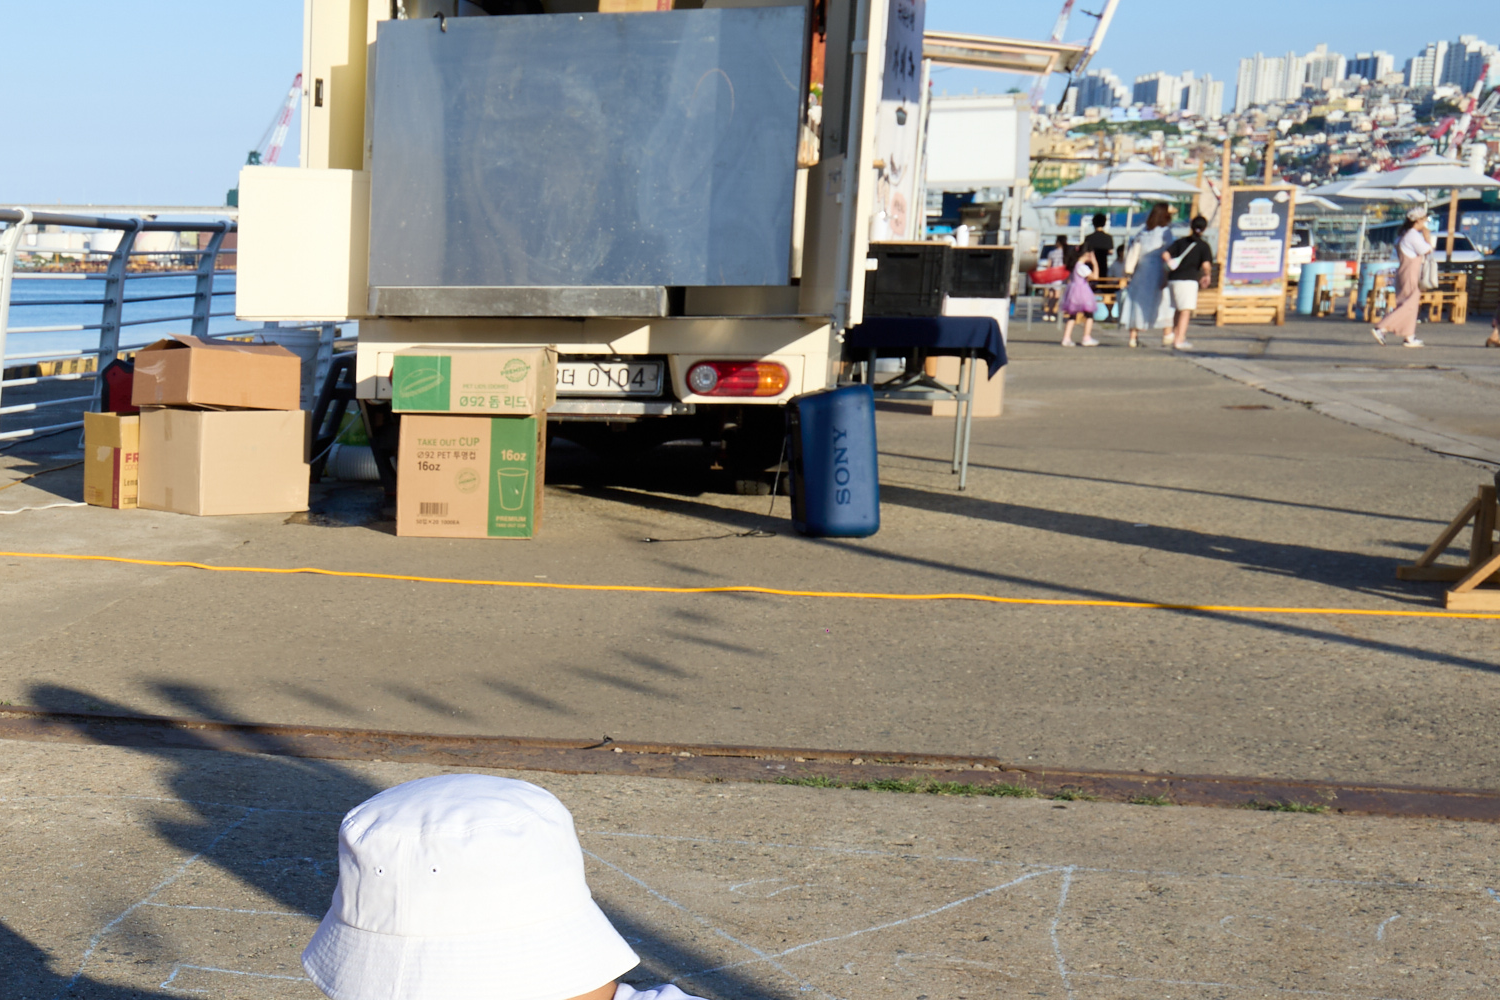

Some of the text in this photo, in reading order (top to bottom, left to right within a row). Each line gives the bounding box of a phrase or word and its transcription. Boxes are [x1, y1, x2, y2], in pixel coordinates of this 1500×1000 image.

[588, 367, 645, 387] 0104
[489, 395, 500, 409] 돔
[504, 395, 527, 409] 리드
[417, 437, 480, 447] TAKE OUT CUP
[437, 451, 451, 459] PET
[453, 451, 476, 460] 투명컵
[501, 449, 527, 461] 16oz
[417, 461, 441, 471] 16oz
[832, 426, 851, 505] SONY
